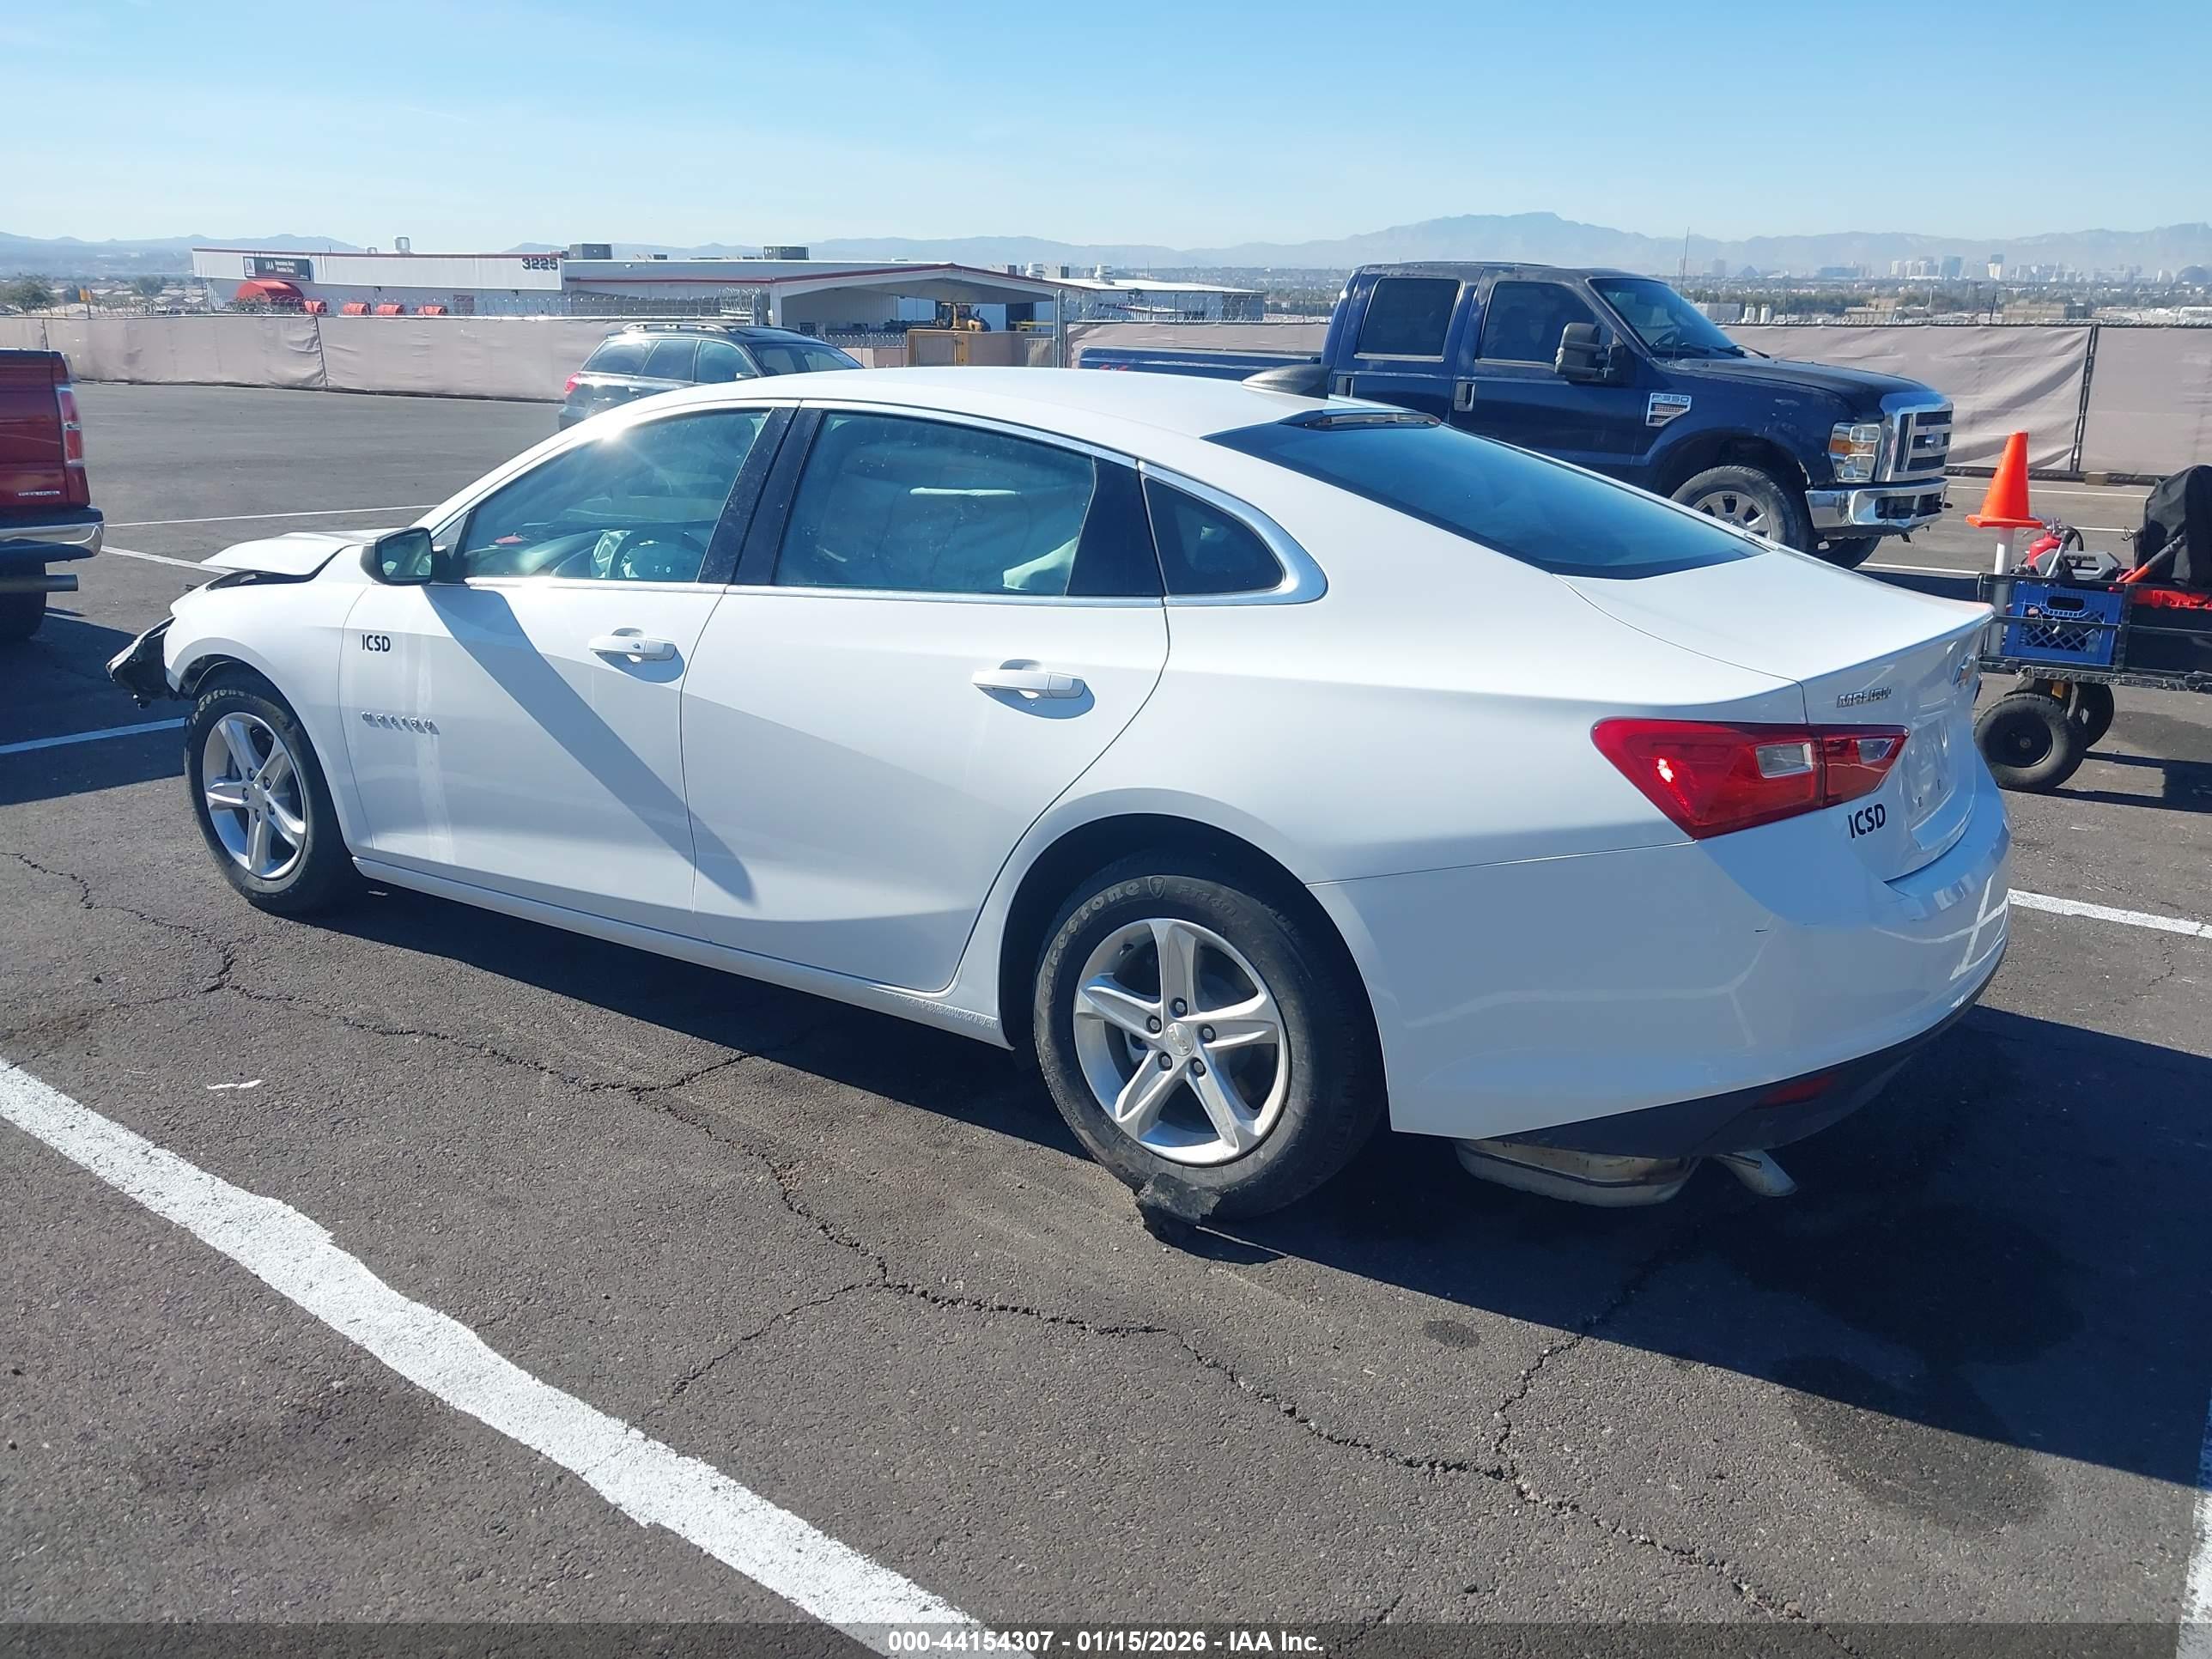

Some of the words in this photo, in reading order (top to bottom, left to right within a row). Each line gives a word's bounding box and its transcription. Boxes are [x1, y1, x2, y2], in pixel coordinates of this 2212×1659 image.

[522, 258, 558, 270] 3225
[362, 634, 391, 653] ICSD
[1847, 803, 1887, 839] ICSD
